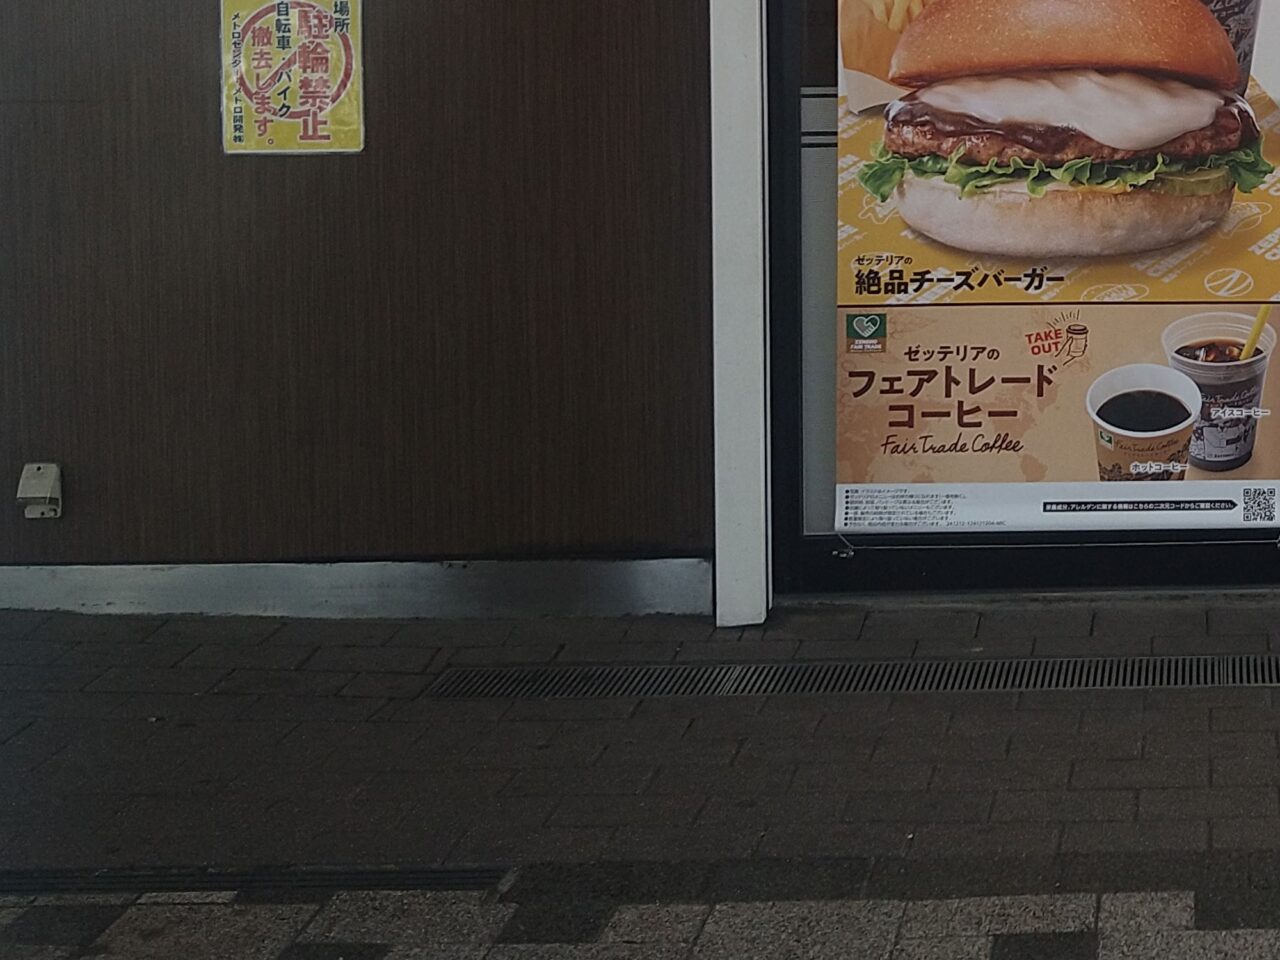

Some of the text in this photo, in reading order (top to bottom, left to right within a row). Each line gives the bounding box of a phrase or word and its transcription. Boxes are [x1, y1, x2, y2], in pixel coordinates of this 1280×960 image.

[296, 8, 334, 141] 駐輪禁止
[855, 255, 913, 265] ゼッテリアの
[855, 266, 1065, 295] 絶品チーズバーガー
[1025, 328, 1063, 344] TAKE
[903, 345, 1000, 362] ゼッテリアの
[1031, 341, 1061, 355] OUT
[848, 364, 1059, 398] フェアトレード
[888, 401, 1018, 428] コーヒー
[1211, 407, 1270, 417] アイスコーヒー
[881, 432, 1024, 454] Fair Trade Coffee
[1131, 462, 1189, 472] ホットコーヒー
